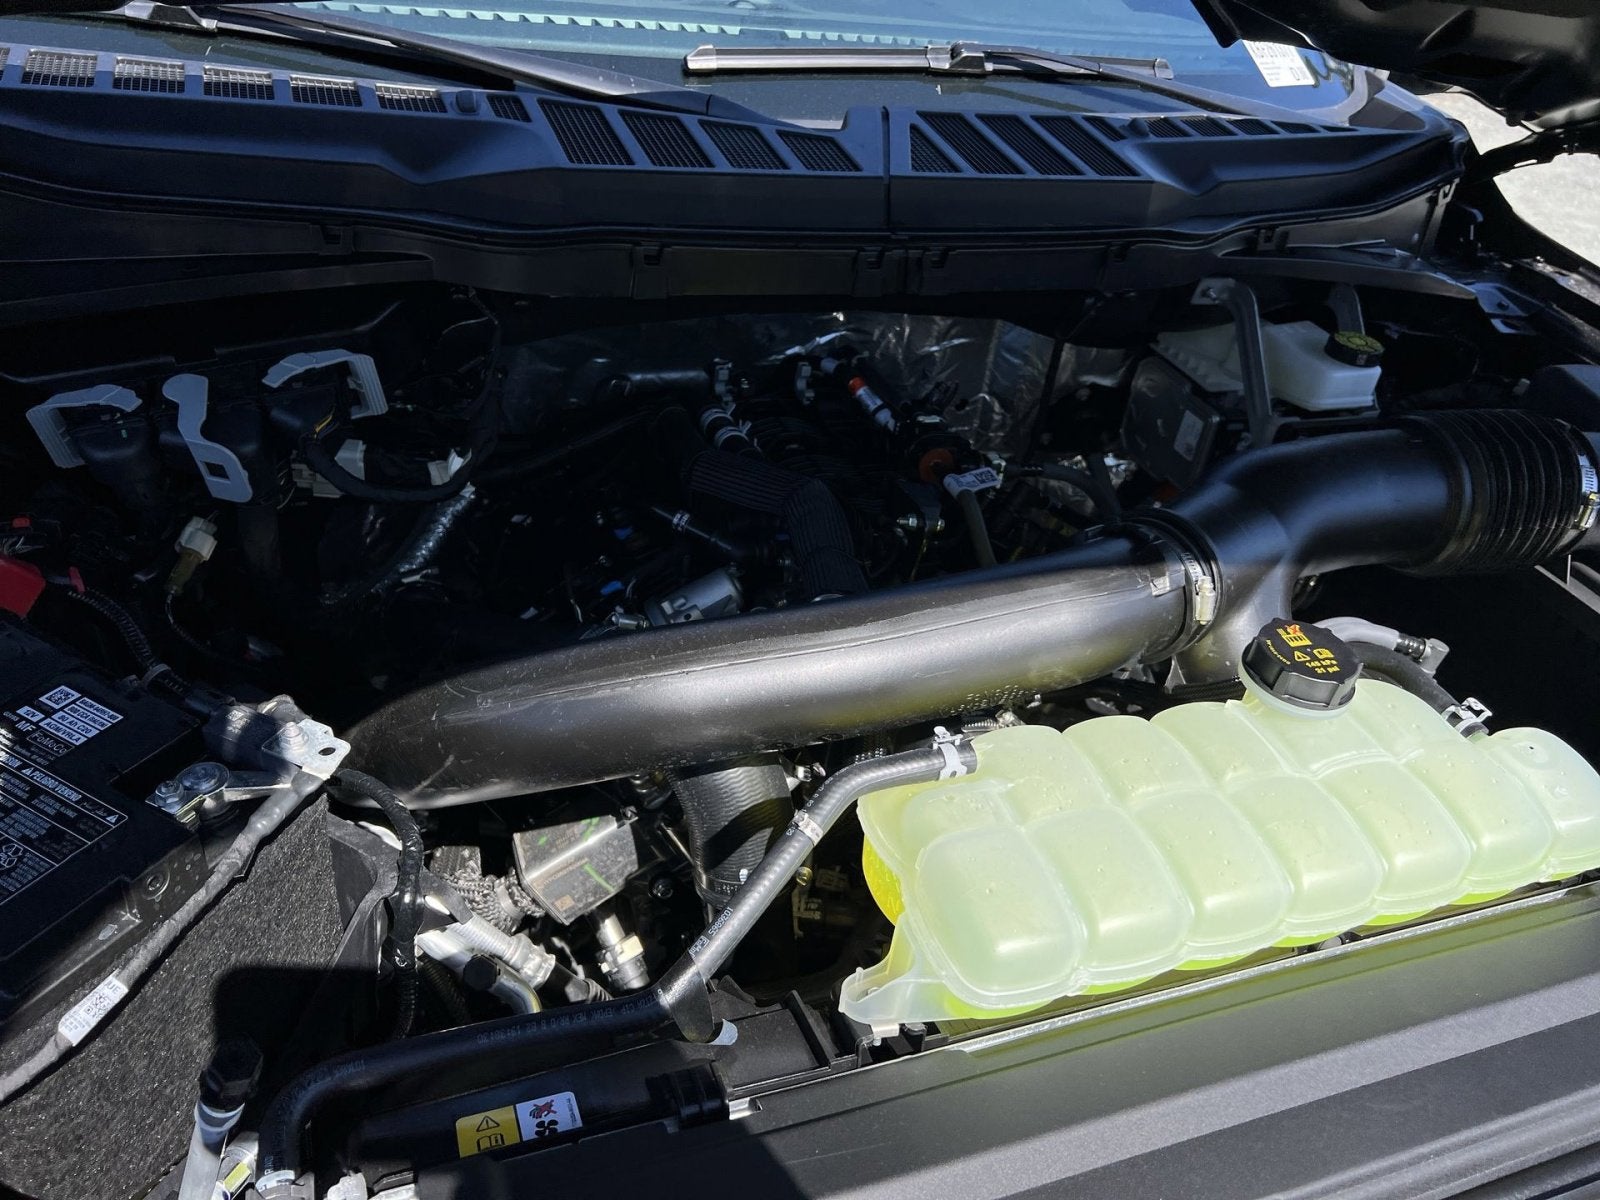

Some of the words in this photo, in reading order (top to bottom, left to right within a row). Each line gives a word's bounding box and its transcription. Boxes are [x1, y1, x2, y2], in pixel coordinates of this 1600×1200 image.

[23, 708, 39, 721] 12V
[15, 720, 37, 732] MF
[67, 717, 80, 728] Ah
[33, 732, 68, 755] FoMoCo
[708, 906, 734, 937] 1036865
